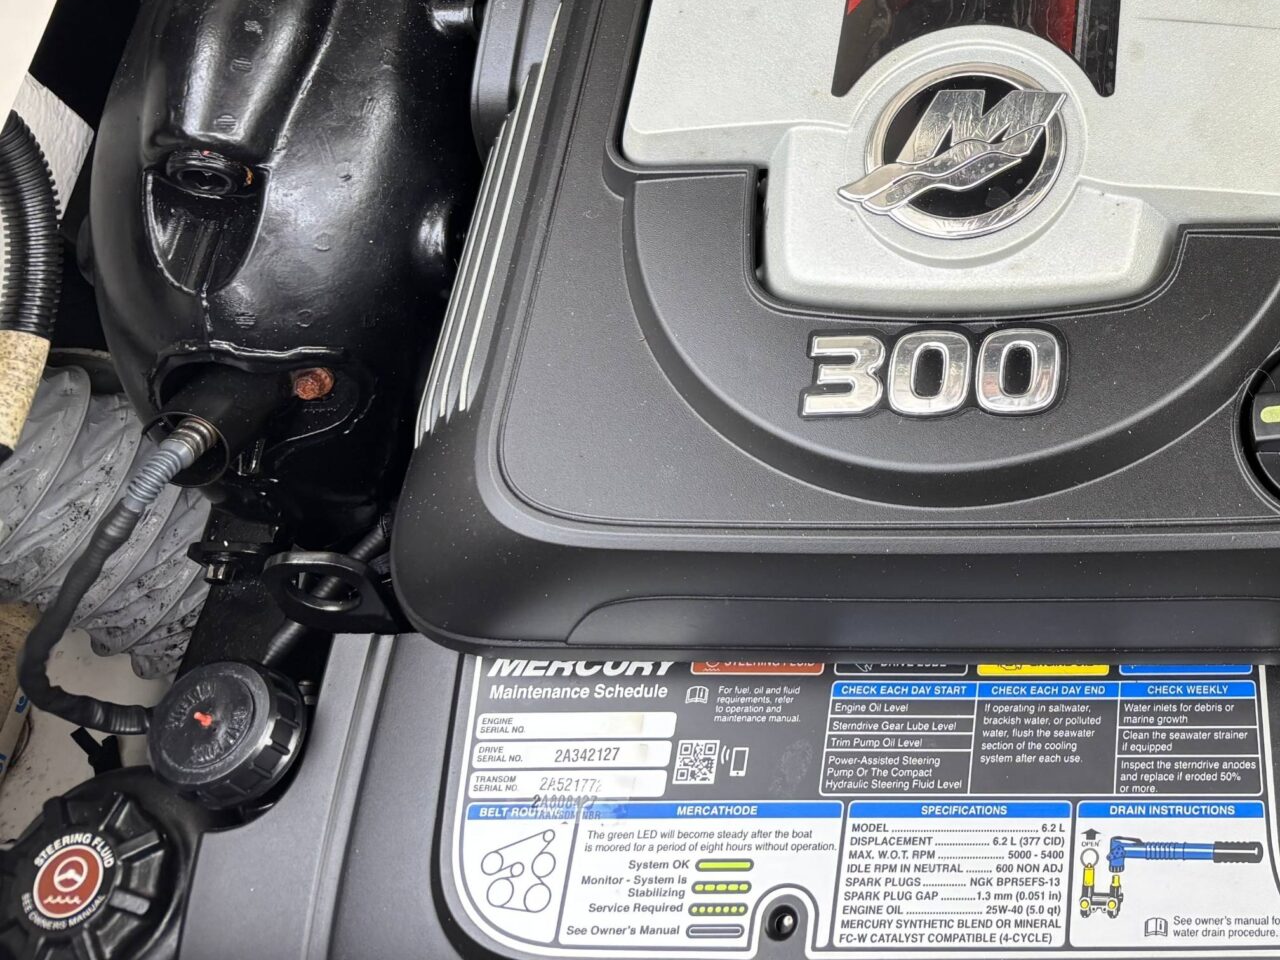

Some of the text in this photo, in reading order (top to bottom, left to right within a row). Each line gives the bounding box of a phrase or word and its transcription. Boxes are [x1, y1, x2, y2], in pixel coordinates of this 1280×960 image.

[803, 329, 1060, 416] 300
[488, 683, 668, 698] Maintenance Schedule
[841, 686, 966, 694] CHECK EACH DAY START
[991, 686, 1105, 694] CHECK EACH DAY END
[1147, 685, 1228, 694] CHECK WEEKLY
[834, 702, 908, 713] Engine Oil Level
[768, 714, 800, 722] manual.
[982, 728, 1095, 737] water, flush the seawater
[1122, 730, 1248, 739] Clean the seawater strainer
[554, 747, 620, 761] 2A342127
[828, 756, 940, 766] Power-Assisted Steering
[1121, 760, 1256, 770] Inspect the sterndrive anodes
[825, 779, 962, 790] Hydraulic Steering Fluid Level
[480, 808, 509, 816] BELT
[676, 806, 757, 815] MERCATHODE
[920, 805, 1007, 814] SPECIFICATIONS
[1109, 805, 1235, 814] DRAIN INSTRUCTIONS
[851, 823, 1065, 832] MODEL 6.2 L
[587, 829, 812, 841] The green LED will become steady after the boat
[34, 833, 114, 868] STEERING FLUID
[848, 850, 874, 859] MAX.
[877, 850, 908, 859] W.O.T.
[911, 850, 935, 858] RPM
[1007, 850, 1031, 859] 5000
[1040, 850, 1064, 859] 5400
[628, 859, 690, 871] System OK
[581, 875, 624, 884] Monitor
[633, 875, 674, 885] System
[677, 875, 687, 884] Is
[845, 877, 1060, 886] SPARK PLUGS NGK BPR5EFS-13
[627, 887, 685, 899] Stabilizing
[843, 891, 880, 900] SPARK
[883, 891, 912, 900] PLUG
[915, 891, 938, 900] GAP
[977, 891, 991, 900] 1.3
[1015, 891, 1044, 902] (0.051
[1048, 891, 1061, 902] in)
[588, 902, 683, 914] Service Required
[842, 905, 1060, 916] ENGINE OIL 25W-40 (5.0 qt)
[566, 925, 680, 934] See Owner's Manual
[1172, 928, 1278, 938] water drain procedure.
[838, 933, 1052, 944] FC-W CATALYST COMPATIBLE (4-CYCLE)
